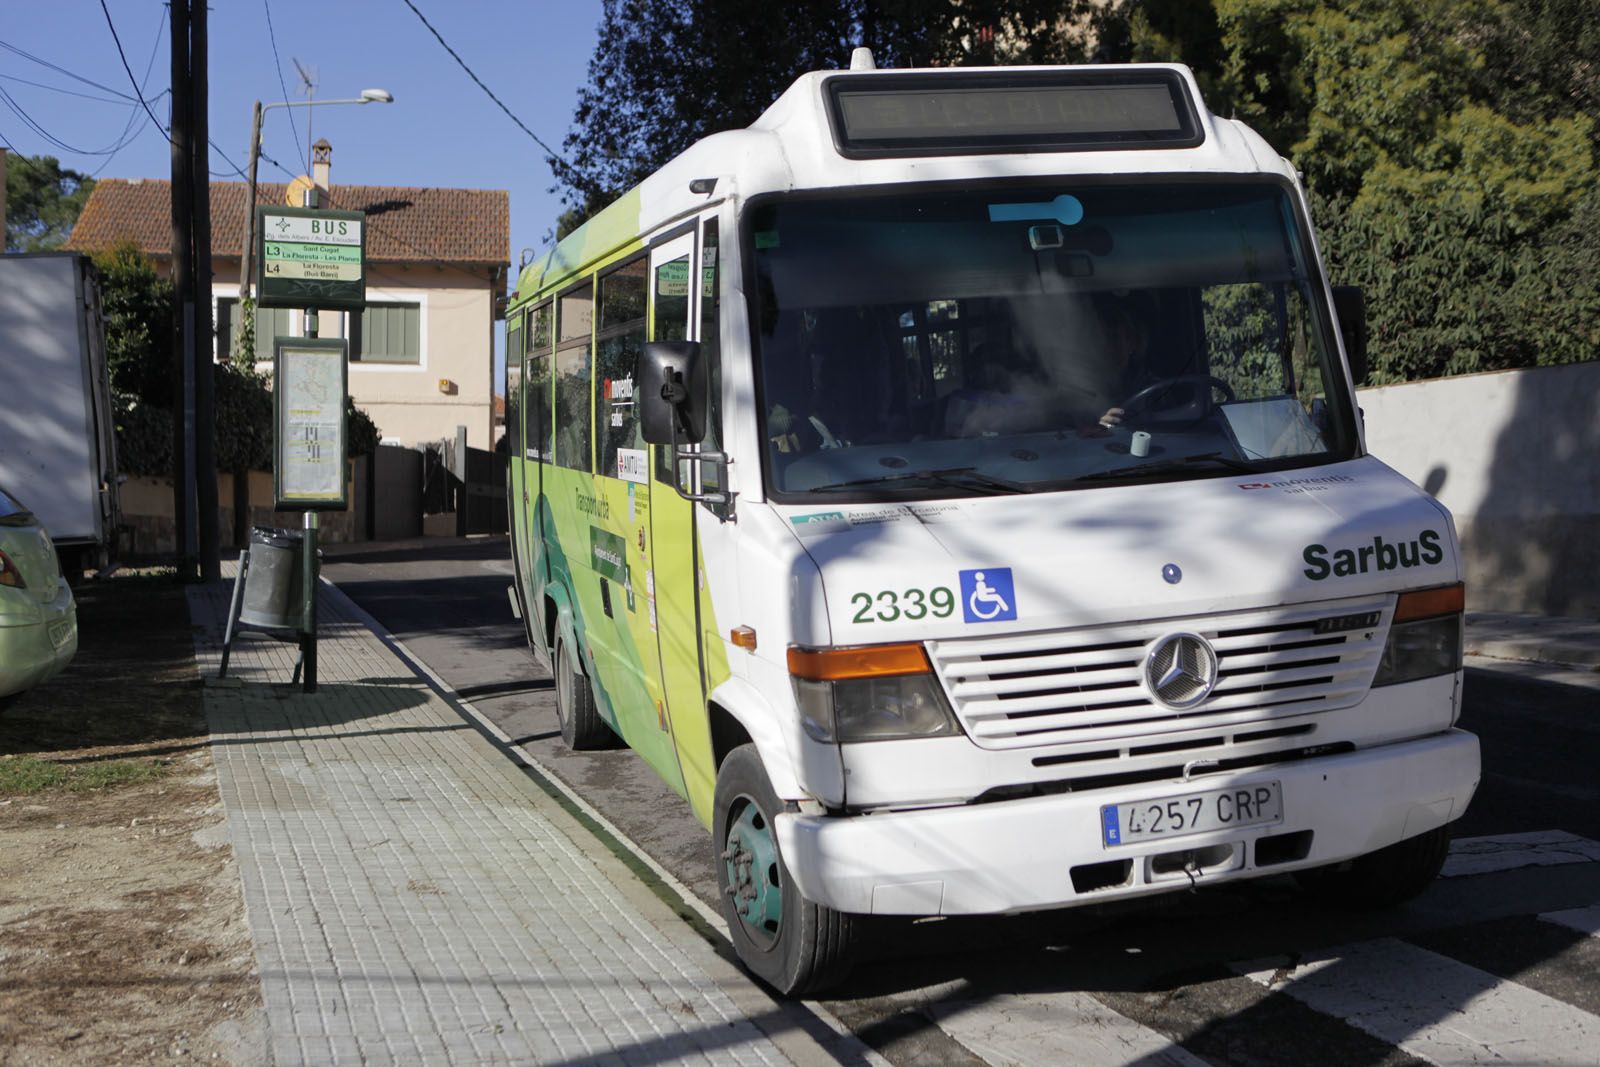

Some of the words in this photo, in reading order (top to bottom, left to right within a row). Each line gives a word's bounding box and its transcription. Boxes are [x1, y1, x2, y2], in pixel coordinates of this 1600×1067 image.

[311, 220, 348, 235] BUS
[266, 246, 280, 256] L3
[319, 246, 340, 254] Cugat
[266, 263, 280, 273] L4
[611, 371, 633, 399] moventis
[1271, 474, 1355, 489] moventis
[575, 487, 597, 520] Transport
[897, 504, 960, 514] Brcelona
[808, 512, 840, 524] ATM
[850, 586, 955, 624] 2339
[1128, 797, 1203, 834] 4257
[1217, 787, 1271, 823] CRP
[1109, 829, 1116, 839] E
